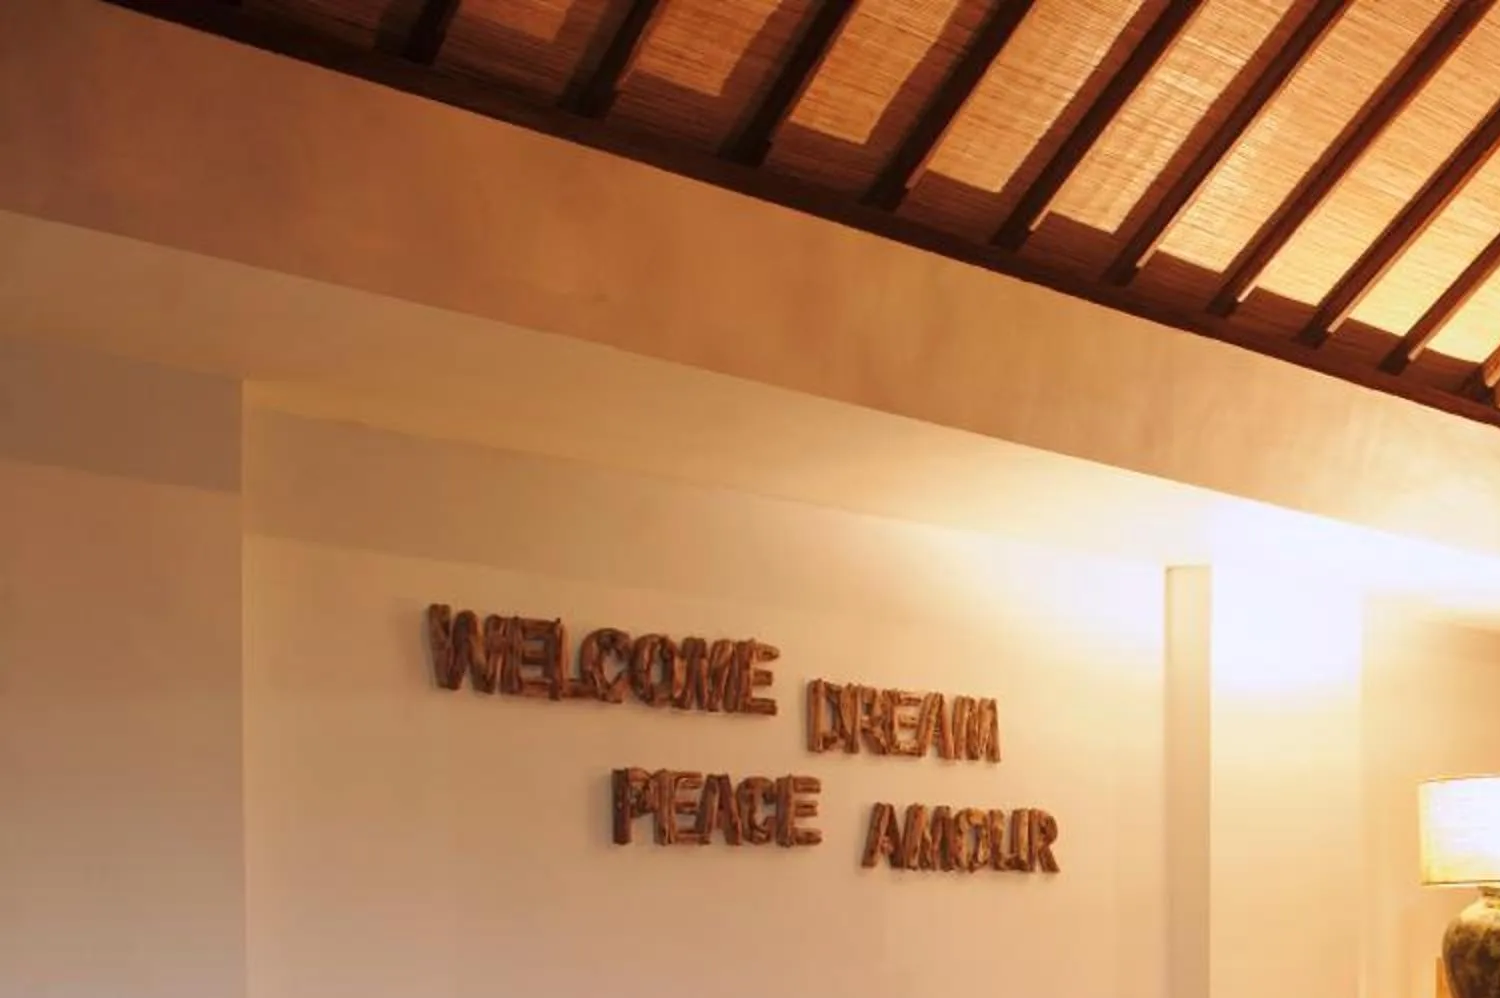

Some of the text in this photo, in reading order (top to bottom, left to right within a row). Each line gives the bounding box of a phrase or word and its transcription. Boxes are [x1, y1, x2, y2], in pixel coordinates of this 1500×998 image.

[427, 602, 780, 716] WELCOME
[805, 677, 1001, 763] DREAM
[611, 766, 823, 847] PEACE
[860, 801, 1060, 873] AMOUR
